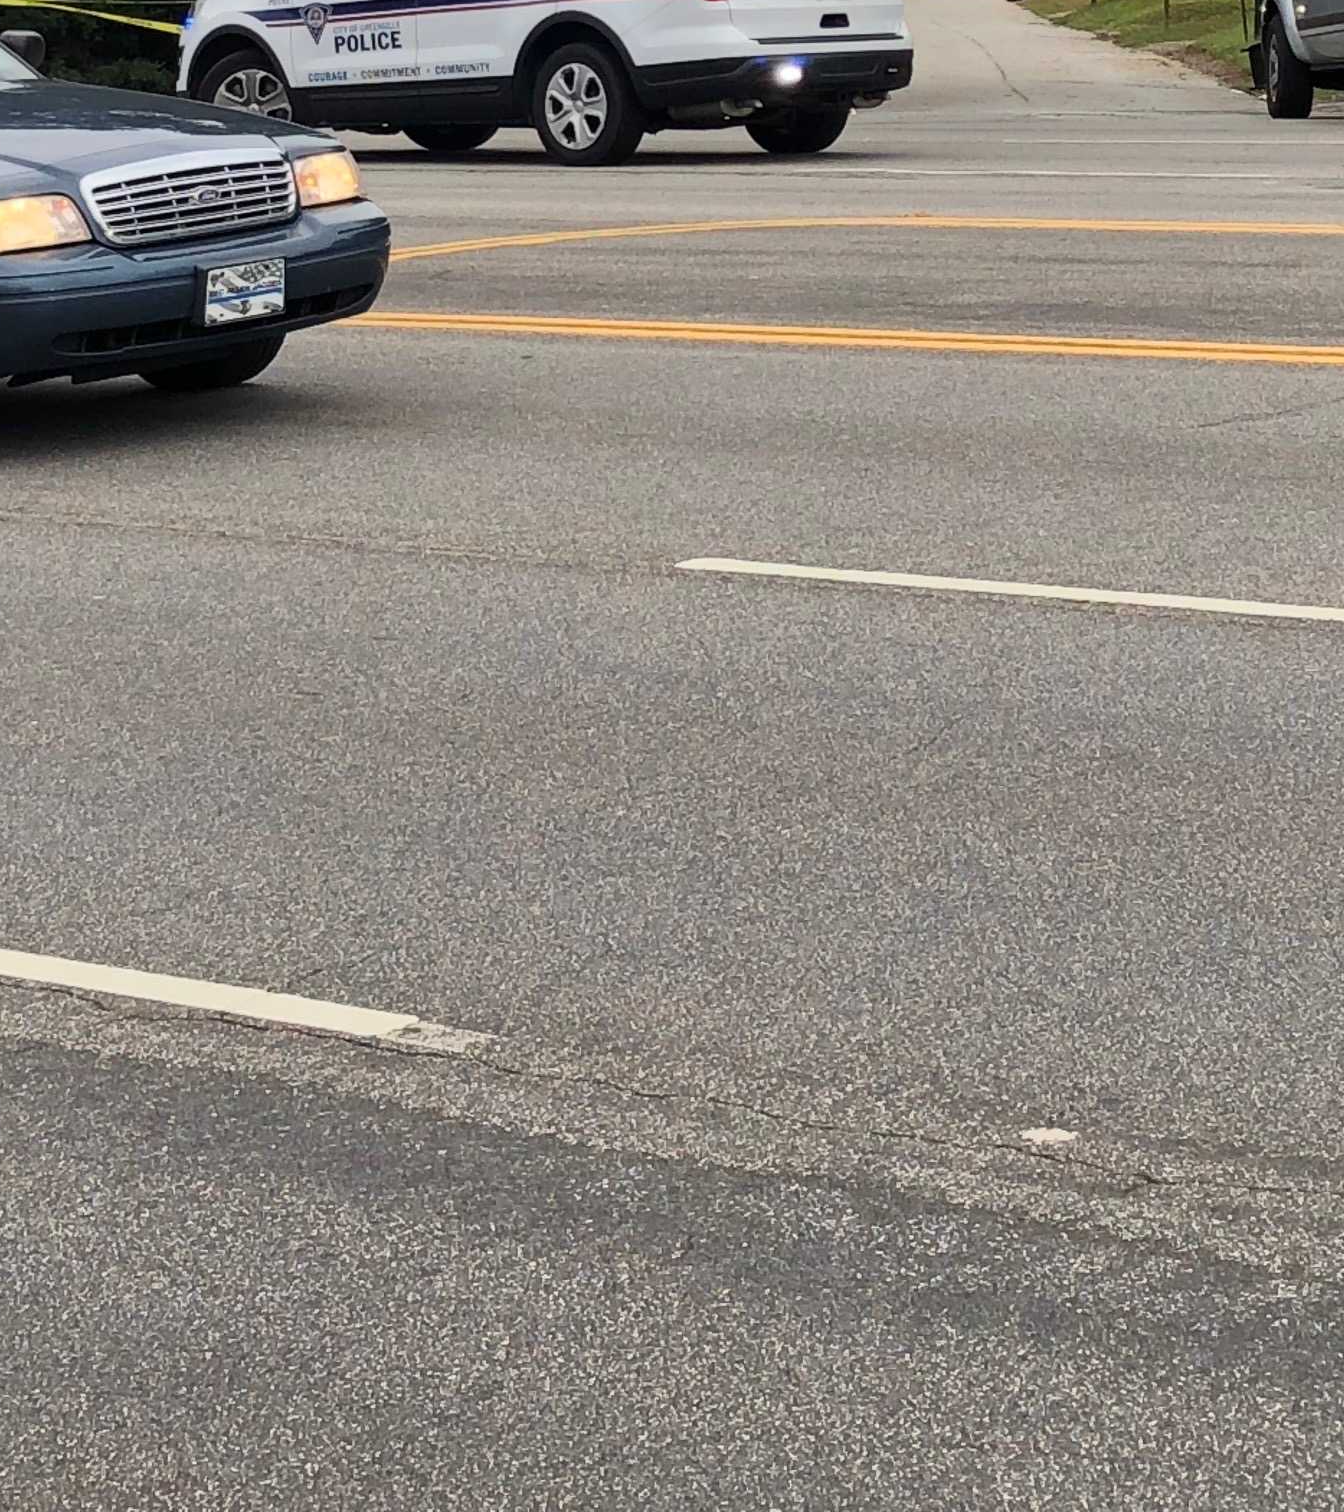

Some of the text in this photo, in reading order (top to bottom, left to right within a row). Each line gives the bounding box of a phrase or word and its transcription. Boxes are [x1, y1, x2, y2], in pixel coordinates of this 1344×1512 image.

[334, 31, 402, 54] POLICE
[308, 63, 491, 83] COURAGE COMMITMENT COMMUNITY
